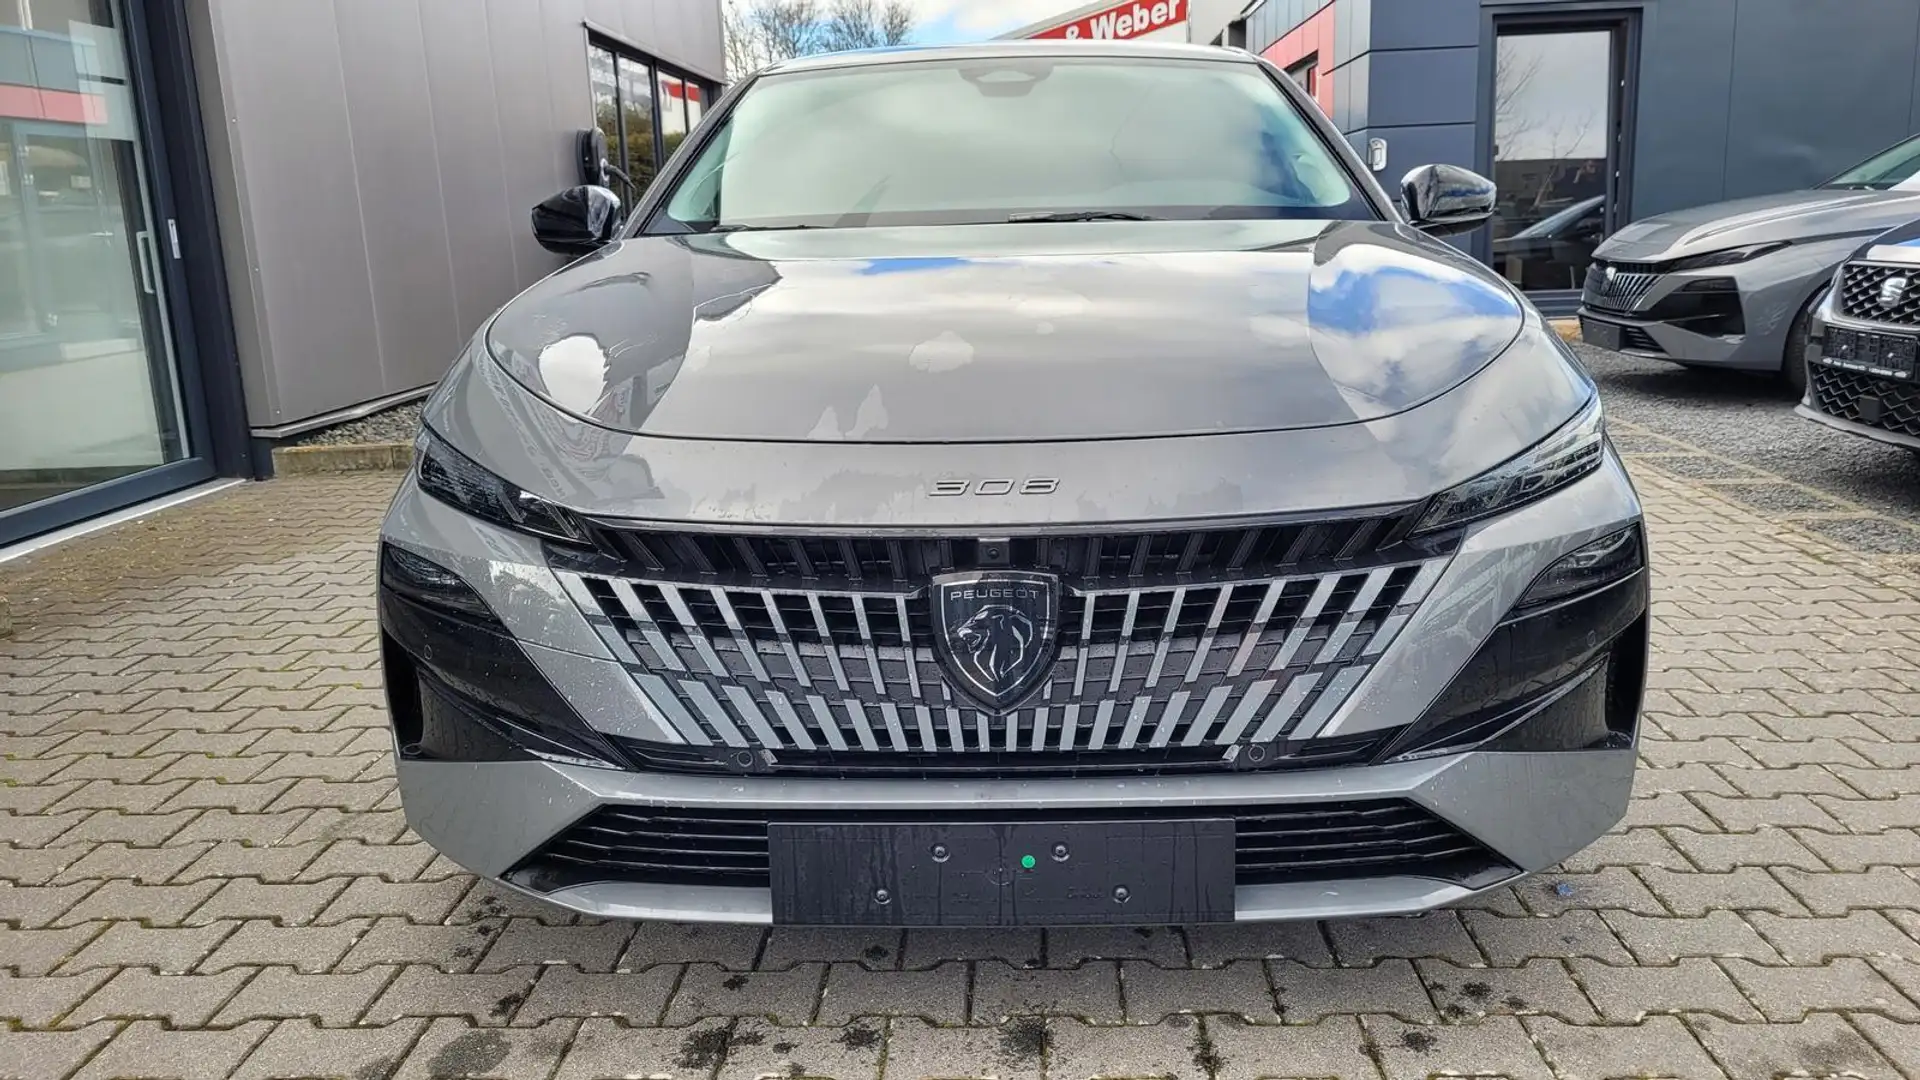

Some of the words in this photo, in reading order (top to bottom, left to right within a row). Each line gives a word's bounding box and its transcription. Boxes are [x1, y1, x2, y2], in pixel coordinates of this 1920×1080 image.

[1090, 0, 1180, 39] Weber
[928, 478, 1060, 497] 308
[950, 588, 1038, 601] PEUGEOT
